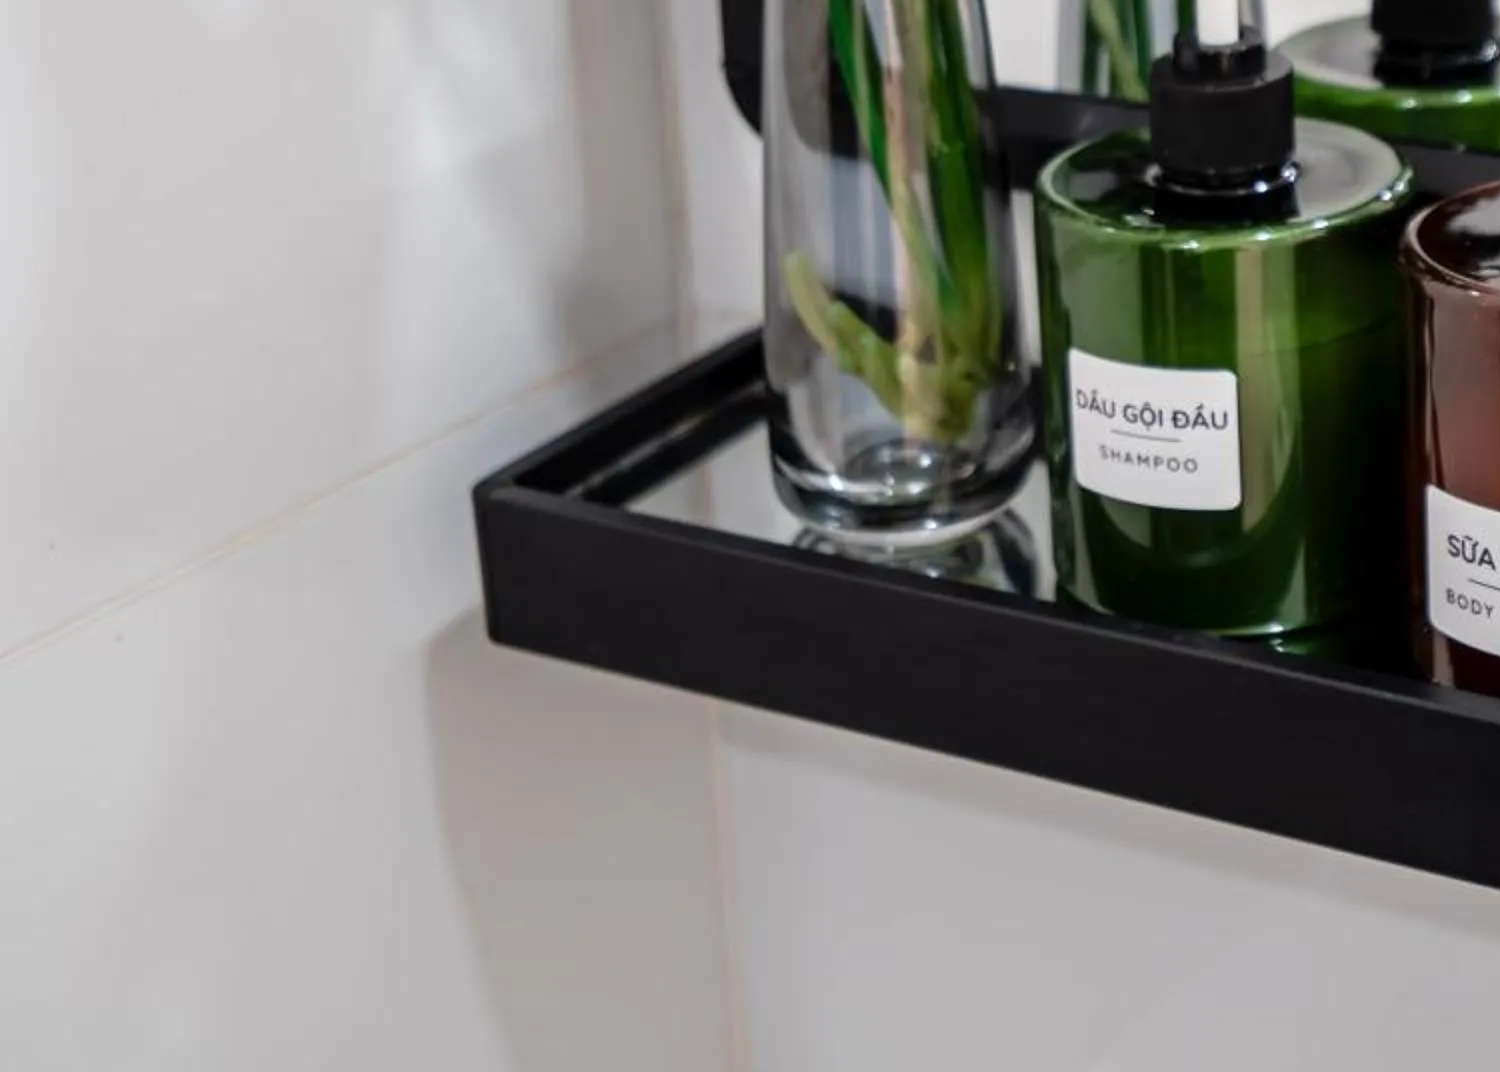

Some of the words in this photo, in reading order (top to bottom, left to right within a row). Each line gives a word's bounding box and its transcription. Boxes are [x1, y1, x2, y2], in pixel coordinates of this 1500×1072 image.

[1122, 402, 1164, 431] GỘI
[1099, 445, 1200, 474] SHAMPOO
[1447, 534, 1497, 571] SỮA
[1446, 589, 1495, 619] BODY
